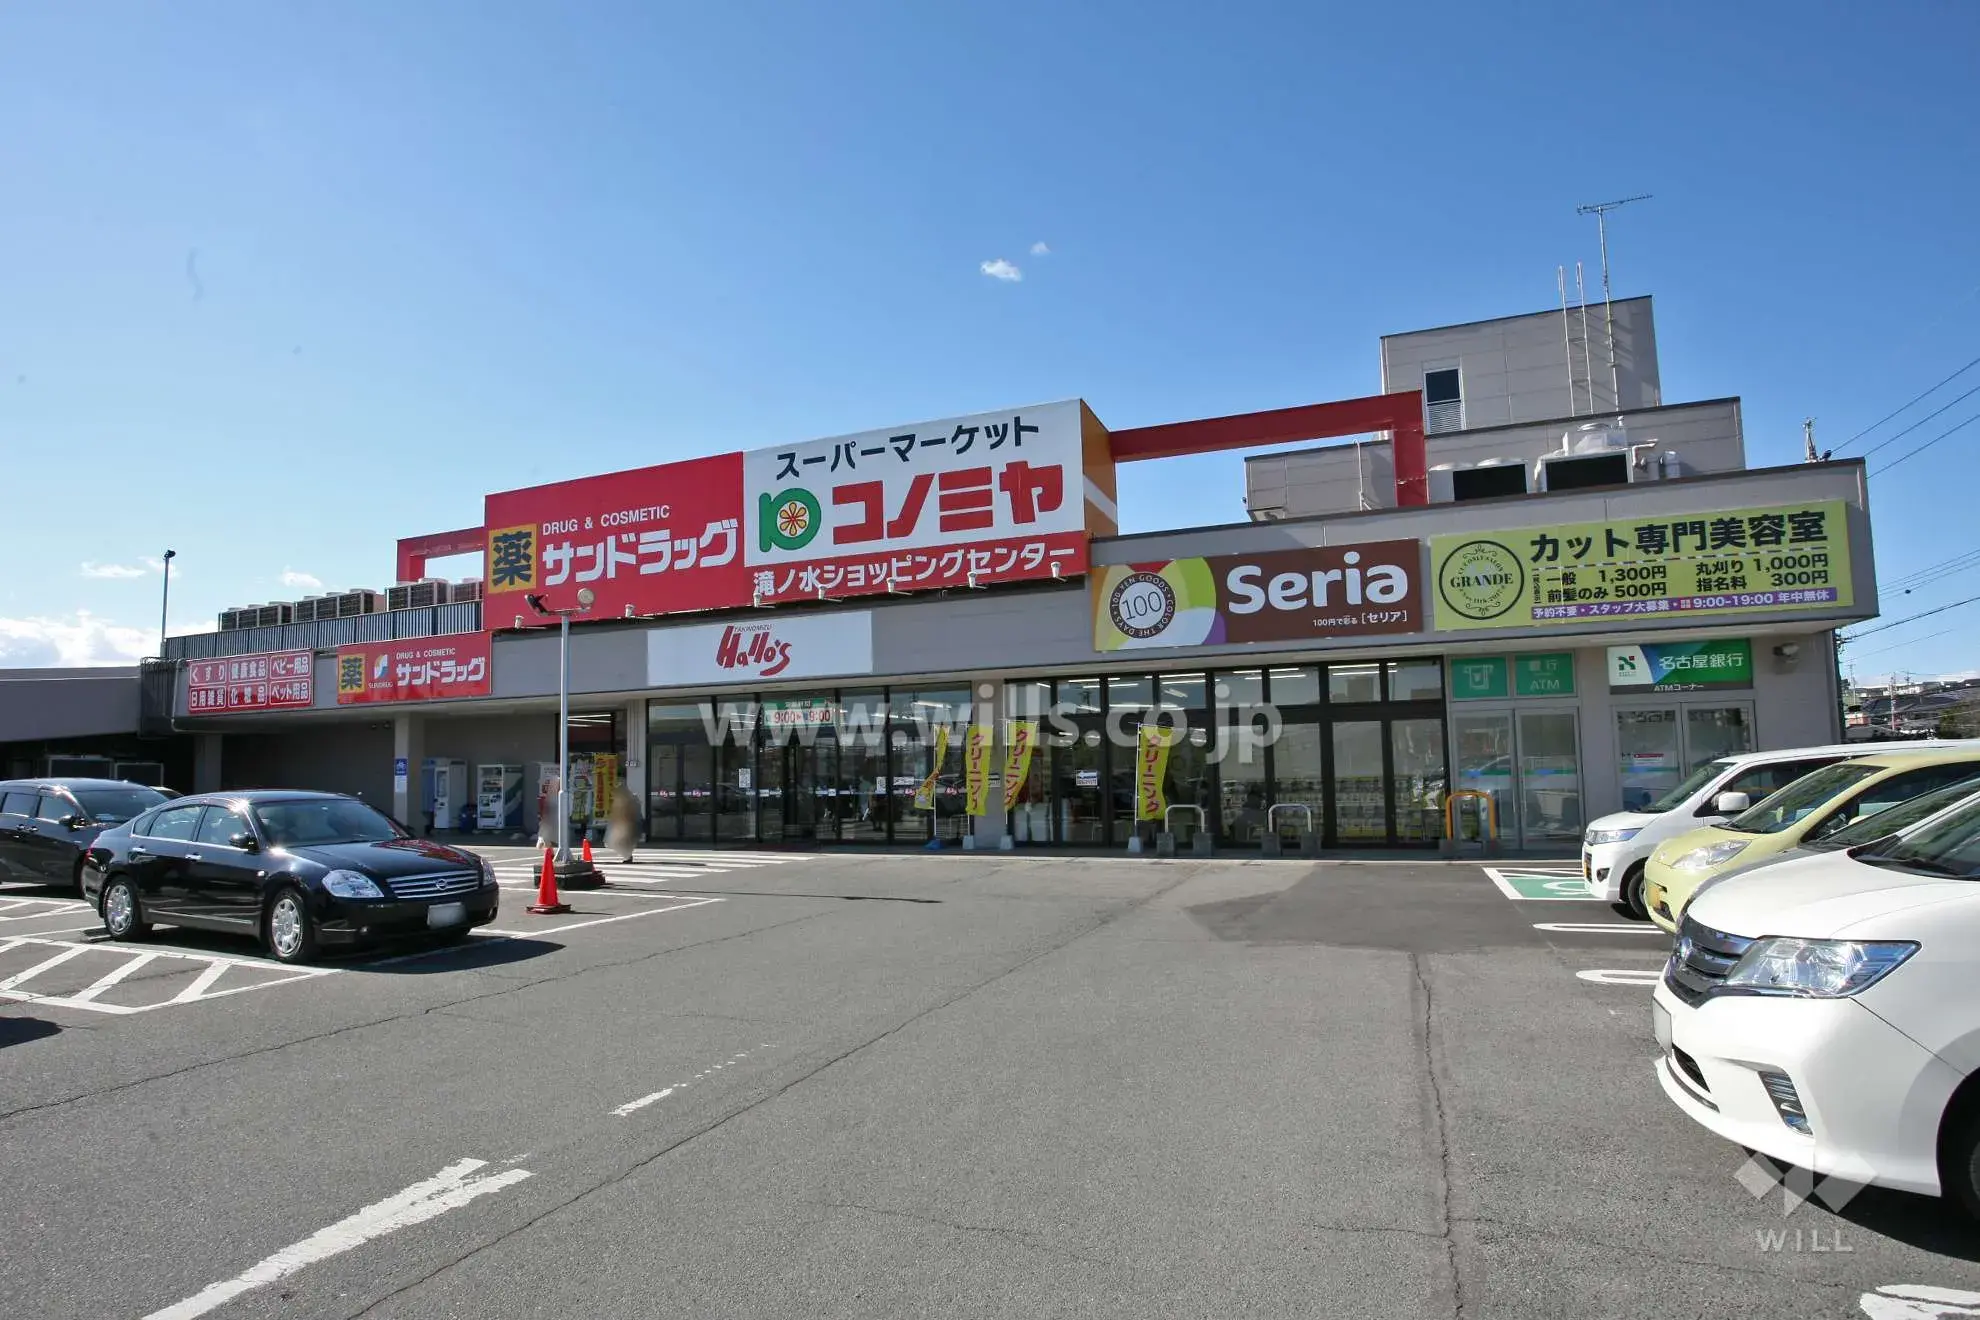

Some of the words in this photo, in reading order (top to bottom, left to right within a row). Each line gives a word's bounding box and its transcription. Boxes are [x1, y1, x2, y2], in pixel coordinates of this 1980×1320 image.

[776, 416, 1039, 480] スーパーマーケット
[832, 460, 1064, 545] コノミヤ
[543, 519, 578, 536] DRUG
[584, 517, 594, 529] &
[601, 505, 670, 527] COSMETIC
[1530, 511, 1828, 562] カット専門美容室
[492, 530, 533, 587] 薬
[542, 518, 738, 586] サンドラッグ
[1696, 560, 1744, 576] 丸刈り
[1753, 553, 1828, 573] 1,000円
[753, 543, 1075, 597] 滝ノ水ショッピングセンター
[1139, 574, 1169, 592] GOODS
[1226, 551, 1408, 614] Seria
[1450, 573, 1514, 588] GRANDE
[1547, 571, 1576, 585] 一般
[1599, 565, 1666, 583] 1,300円
[1696, 575, 1747, 592] 指名料
[1771, 570, 1828, 587] 300円
[1121, 591, 1162, 621] 100
[1547, 586, 1609, 603] 前髪のみ
[1615, 581, 1666, 599] 500円
[1693, 593, 1773, 608] 9:00-19:00
[1778, 589, 1830, 603] 年中無休
[396, 651, 414, 660] DRUG
[424, 647, 456, 657] COSMETIC
[1659, 652, 1744, 670] 名古屋銀行
[341, 656, 363, 691] 薬
[396, 656, 486, 687] サンドラッグ
[1530, 679, 1560, 690] ATM
